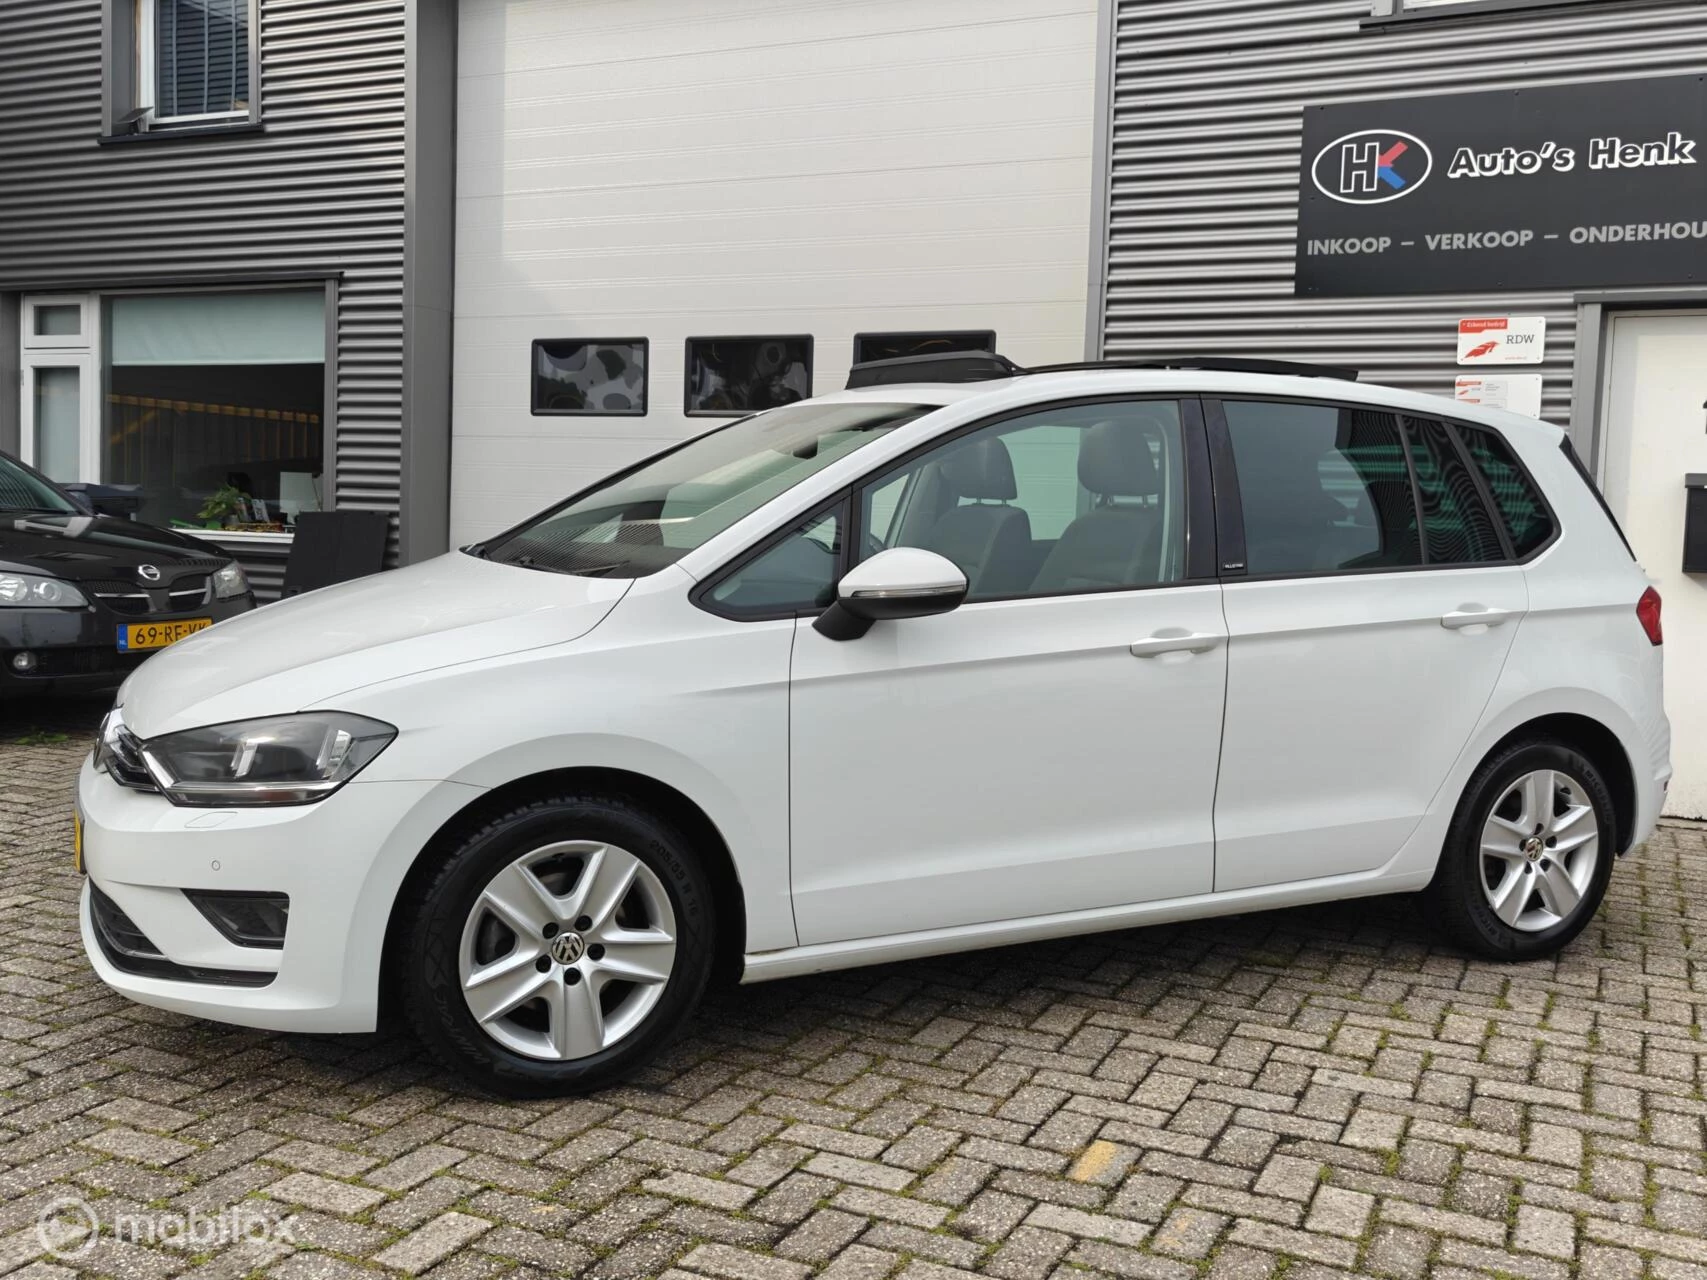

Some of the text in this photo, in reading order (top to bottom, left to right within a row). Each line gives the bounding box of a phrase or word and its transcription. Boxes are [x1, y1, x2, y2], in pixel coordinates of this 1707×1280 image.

[1447, 131, 1697, 178] Auto's Henk
[1306, 236, 1392, 256] INKOOP
[1424, 229, 1534, 251] VERKOOP
[1568, 221, 1707, 245] ONDERHOU
[1505, 334, 1535, 345] RDW
